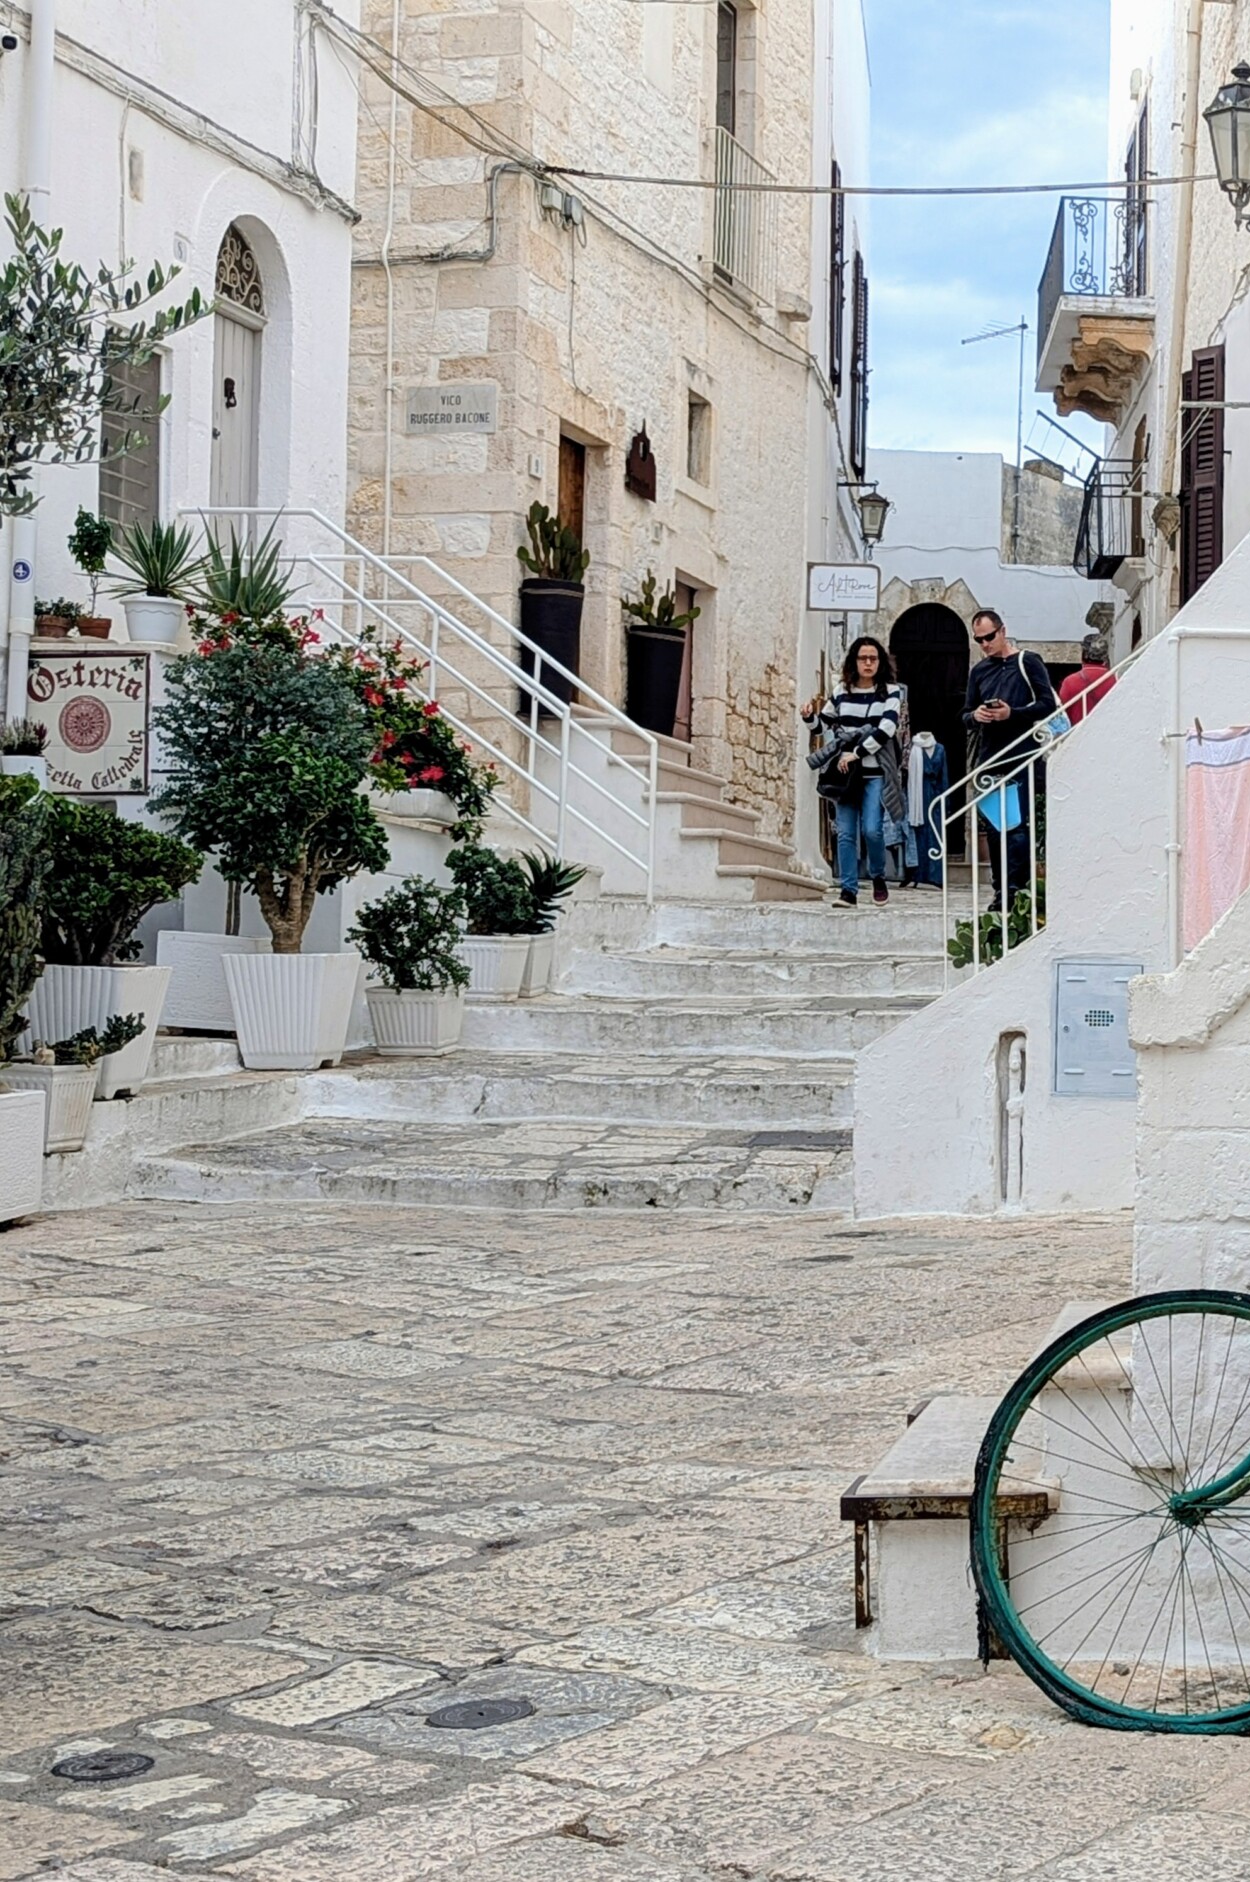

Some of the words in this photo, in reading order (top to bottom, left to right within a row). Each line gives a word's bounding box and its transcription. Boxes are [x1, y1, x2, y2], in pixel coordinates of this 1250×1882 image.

[440, 395, 461, 406] VICO
[410, 413, 452, 424] RUGGERO
[455, 412, 490, 424] BACONE
[27, 660, 142, 702] Osteria
